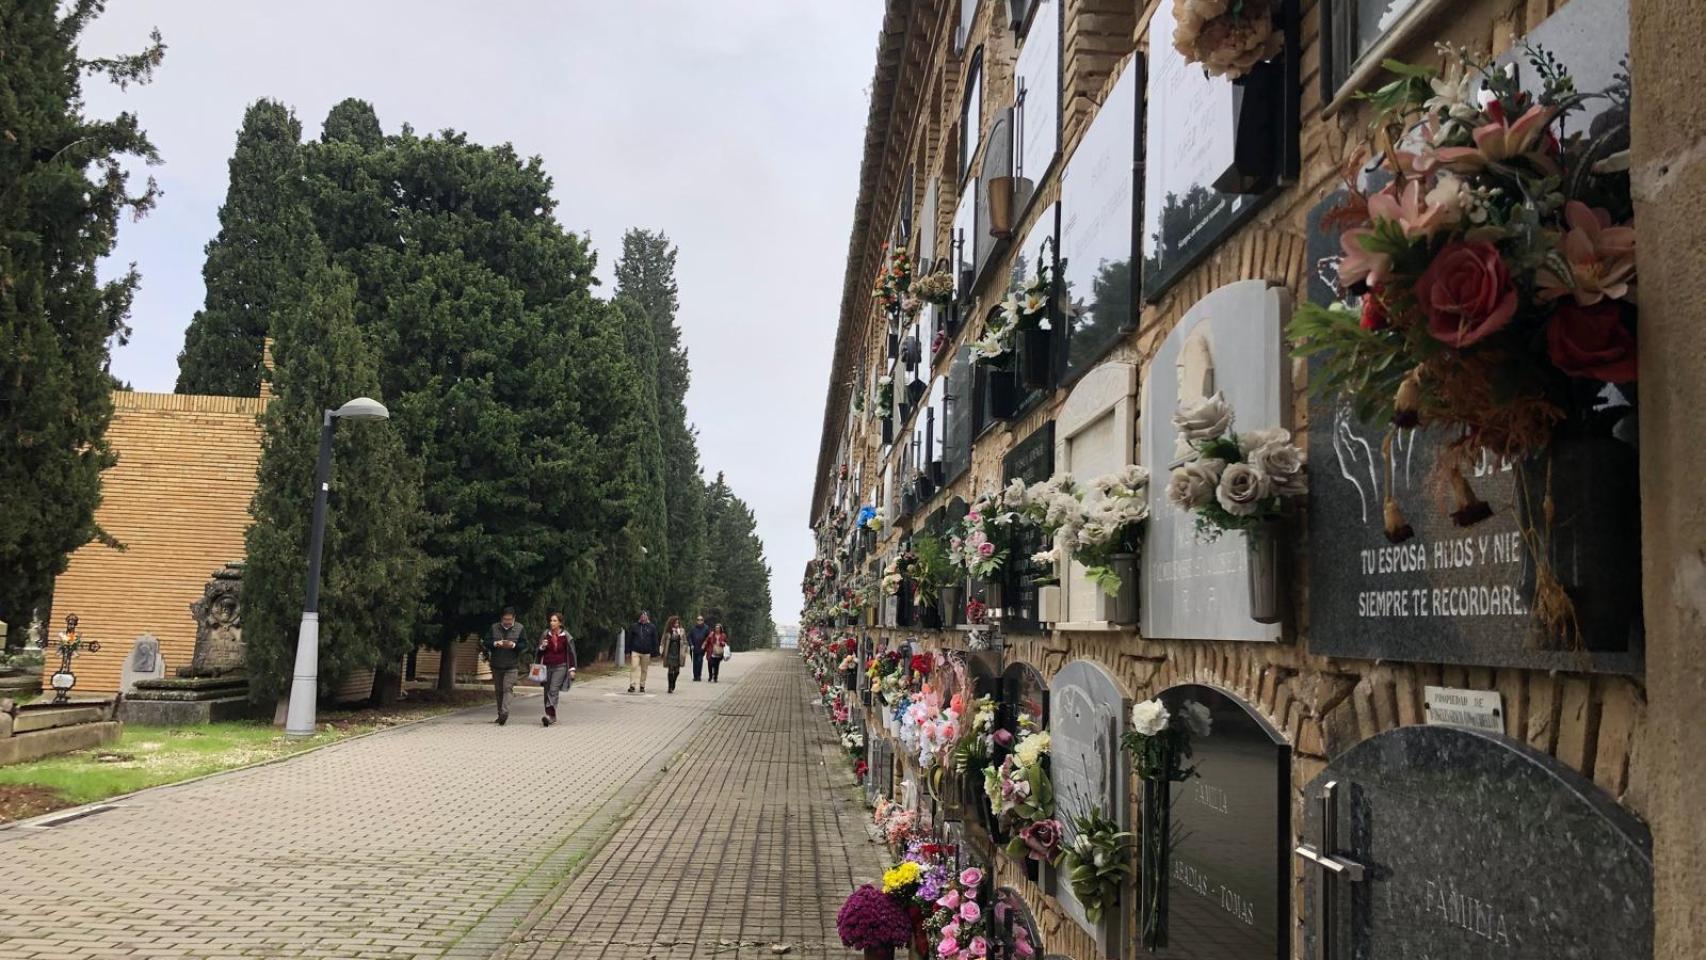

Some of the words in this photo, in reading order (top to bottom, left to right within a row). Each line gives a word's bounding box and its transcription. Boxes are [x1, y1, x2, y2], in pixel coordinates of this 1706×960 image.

[1360, 549, 1376, 575] TU
[1378, 543, 1426, 574] ESPOSA
[1478, 535, 1489, 565] Y
[1358, 590, 1409, 617] SIEMPRE
[1412, 589, 1428, 616] TE
